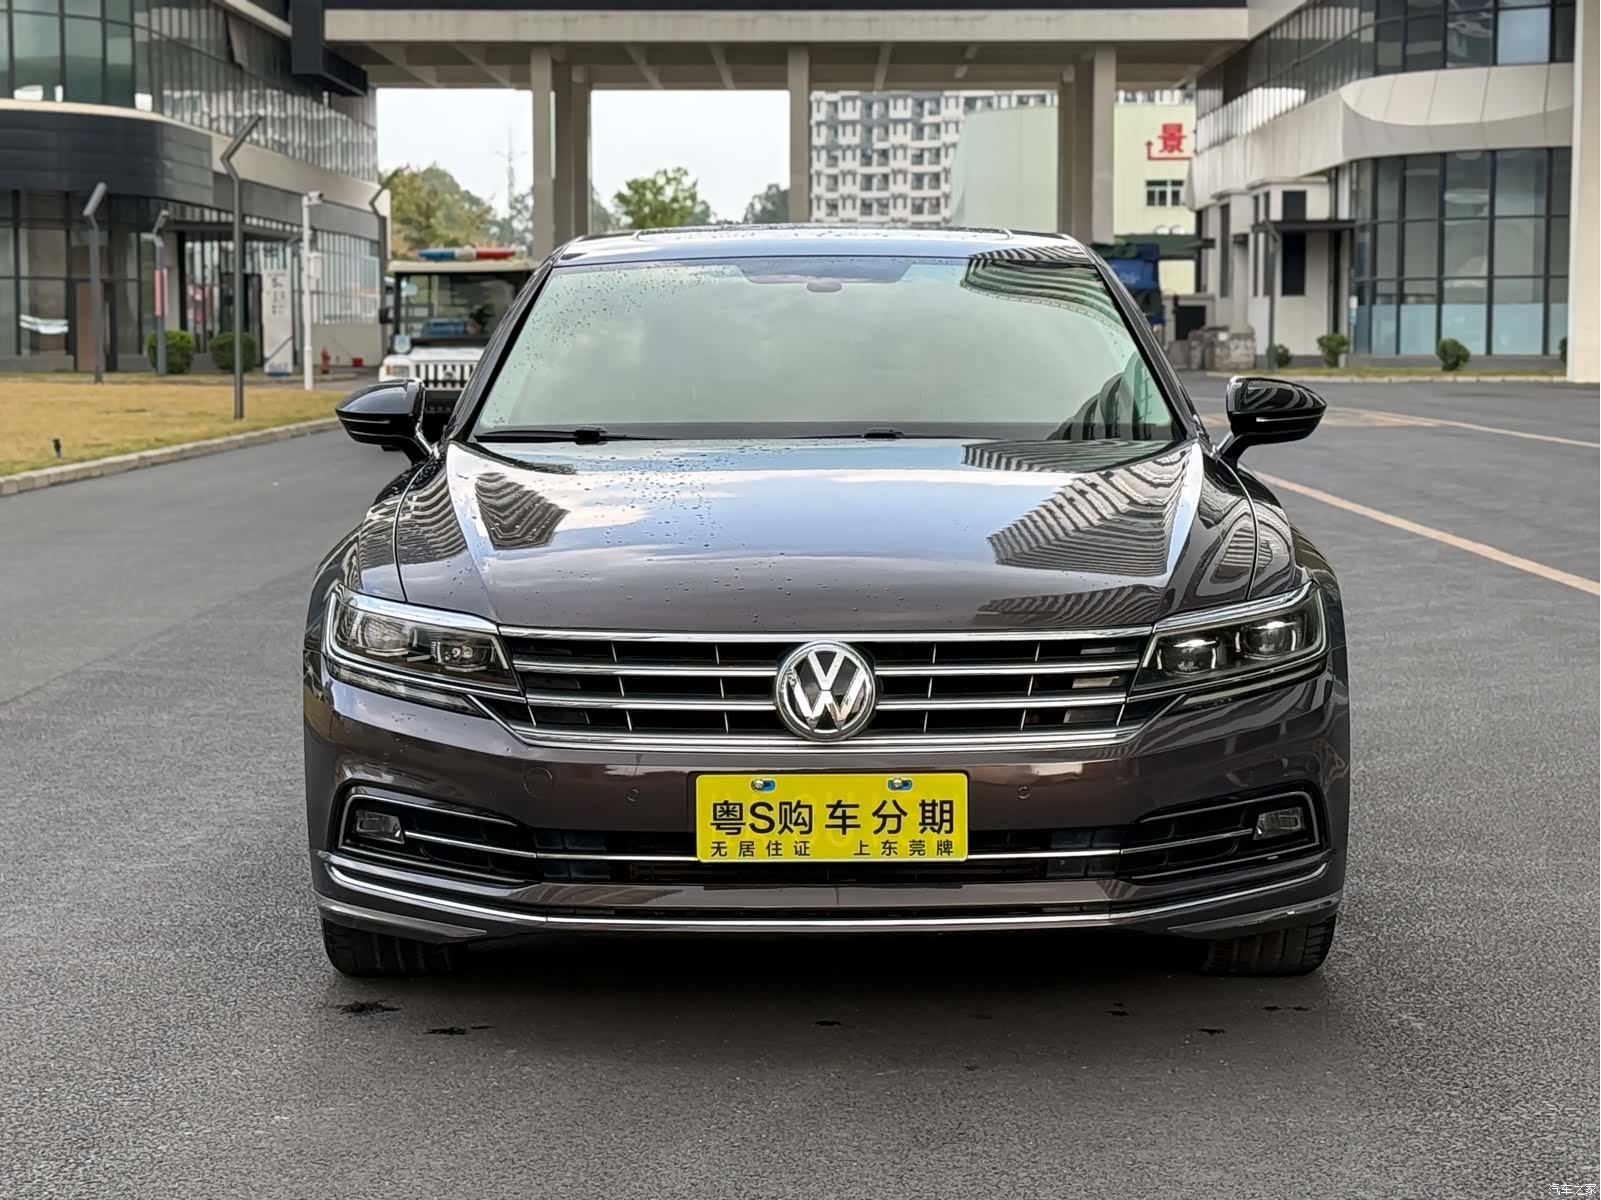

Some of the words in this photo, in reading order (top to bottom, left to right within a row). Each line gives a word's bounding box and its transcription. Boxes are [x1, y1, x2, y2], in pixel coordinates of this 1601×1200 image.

[710, 799, 955, 836] 粤S购车分期
[709, 840, 811, 858] 无居住证
[853, 839, 954, 857] 上东莞牌
